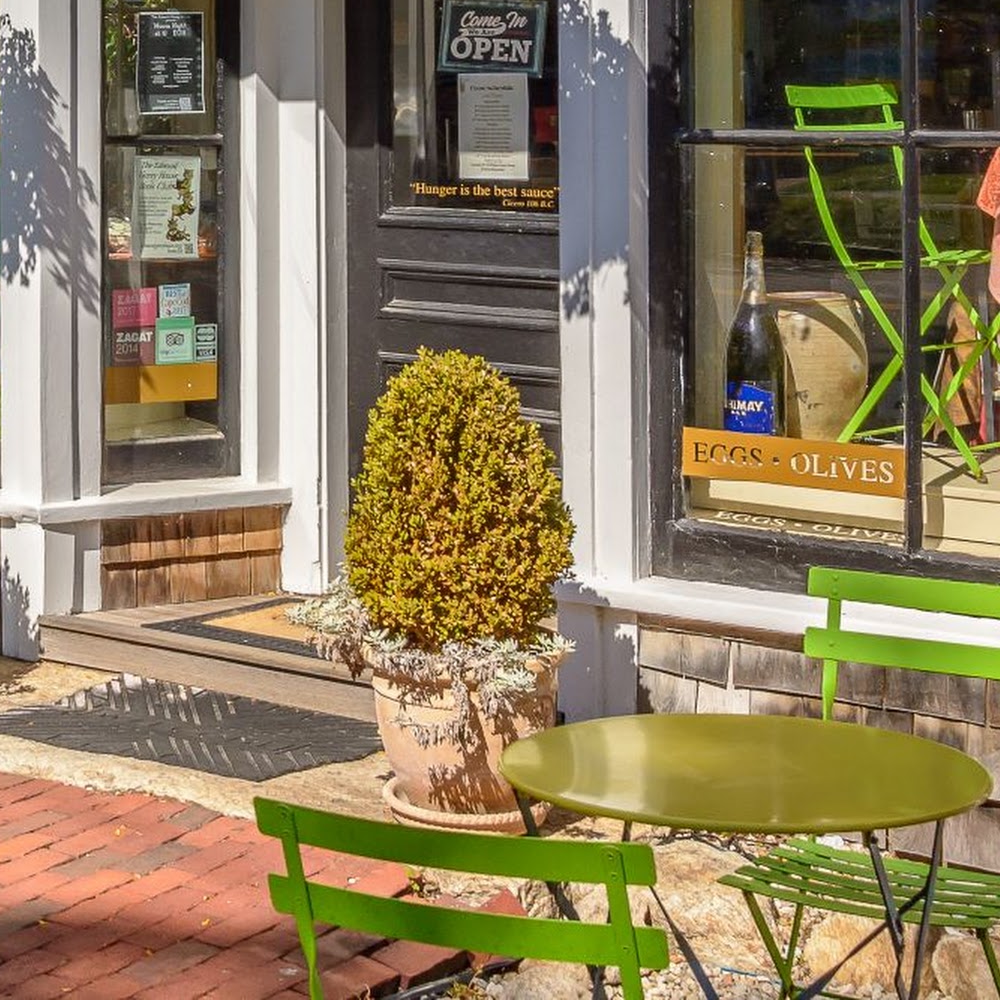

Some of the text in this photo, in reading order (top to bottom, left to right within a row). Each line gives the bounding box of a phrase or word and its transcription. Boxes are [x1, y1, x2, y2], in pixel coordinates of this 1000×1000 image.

[460, 10, 528, 29] Come In
[450, 36, 533, 64] OPEN
[460, 183, 470, 196] is
[472, 183, 491, 197] the
[493, 185, 519, 198] best
[115, 331, 154, 343] ZAGAT
[115, 343, 139, 355] 2014
[693, 441, 895, 484] EGGS OLIVES
